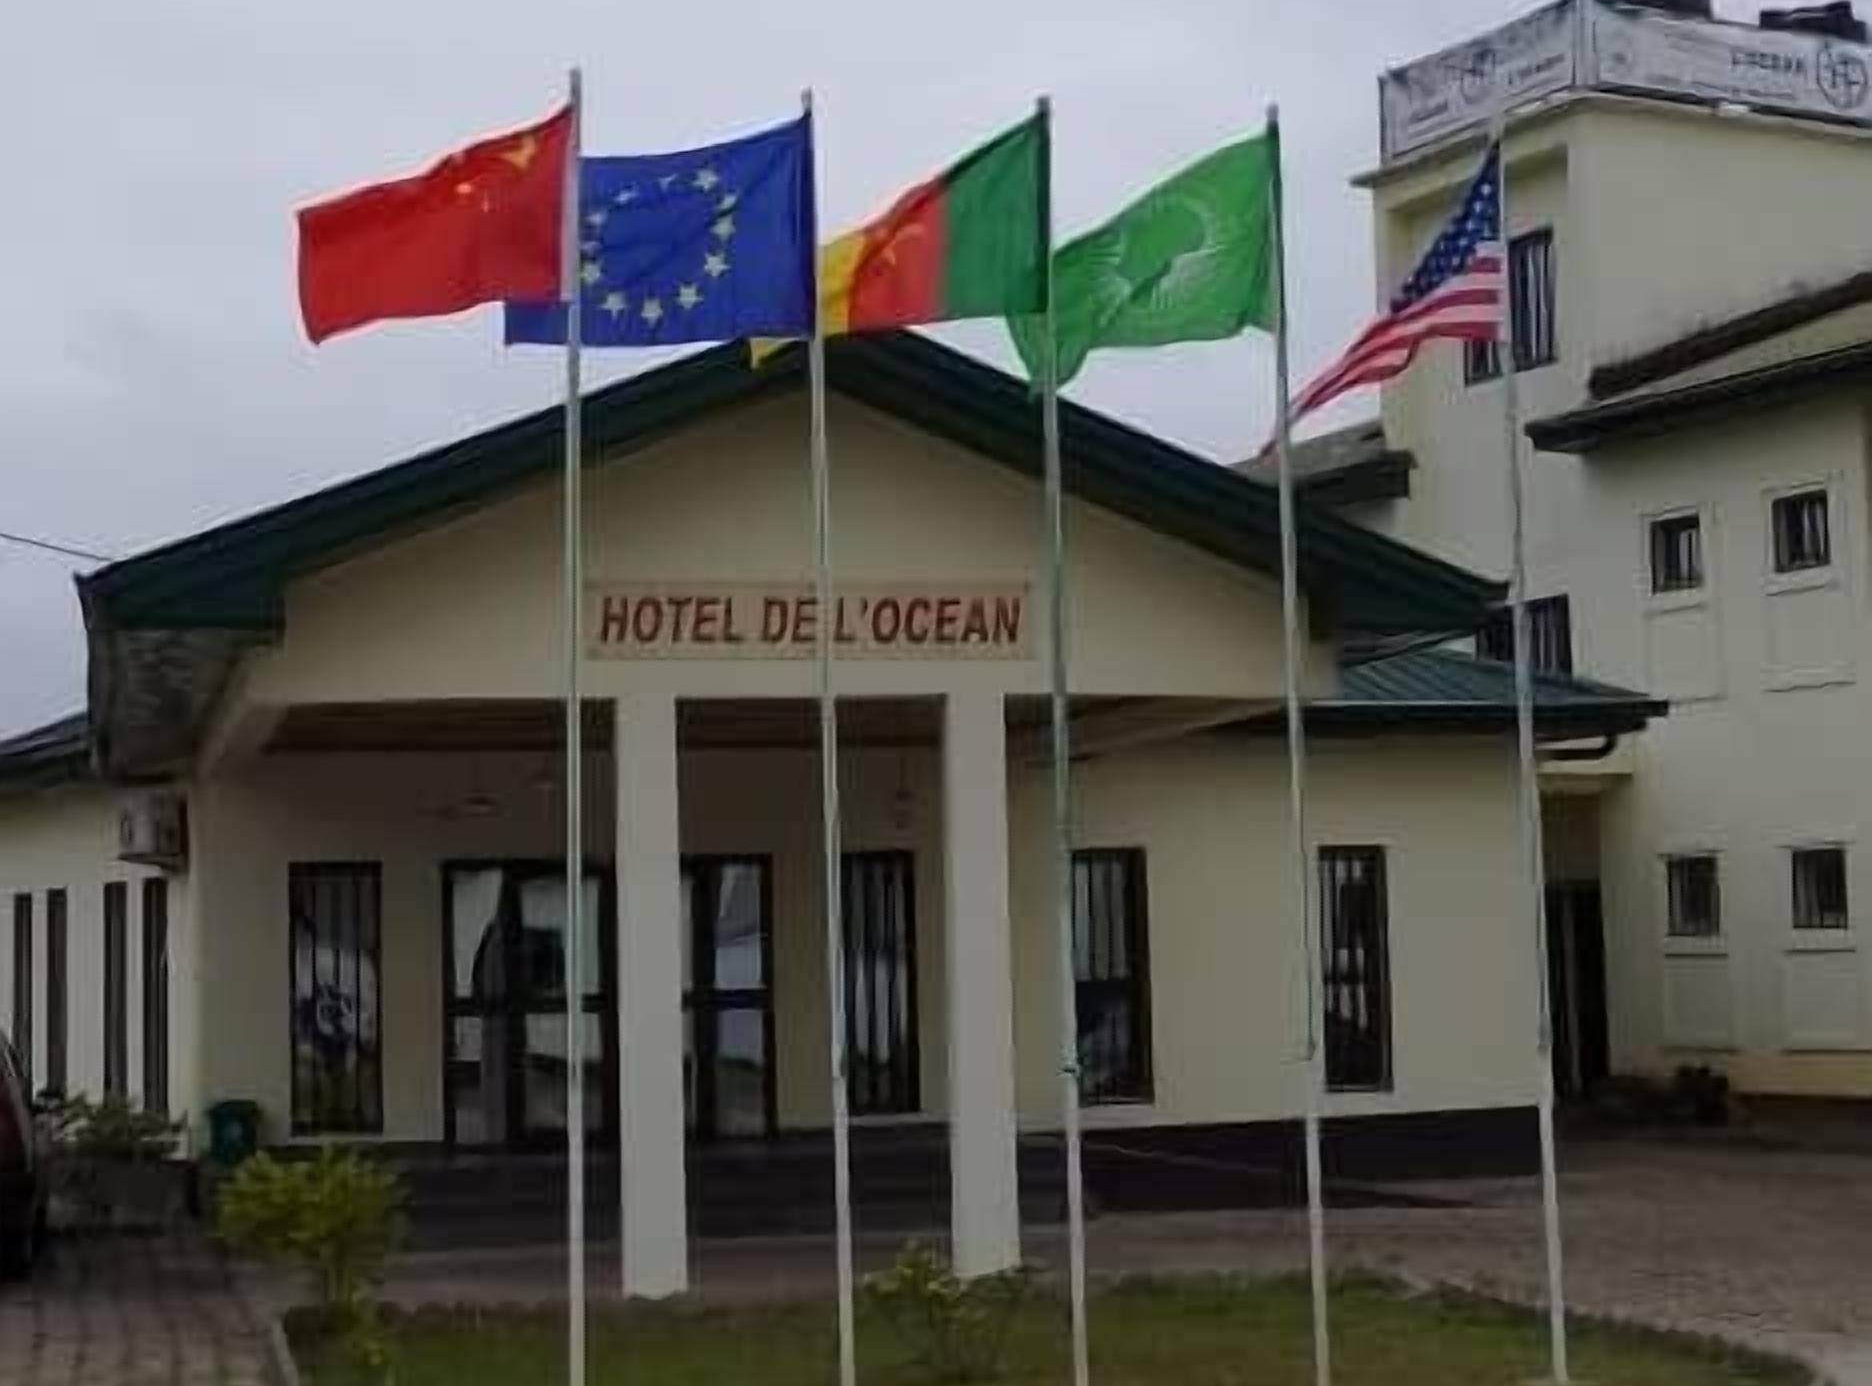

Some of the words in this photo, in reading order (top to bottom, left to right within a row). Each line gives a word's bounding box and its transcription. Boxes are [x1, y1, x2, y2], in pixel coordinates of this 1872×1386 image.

[600, 596, 743, 644] HOTEL
[761, 597, 818, 644] DE
[833, 596, 1021, 644] L'OCEAN
